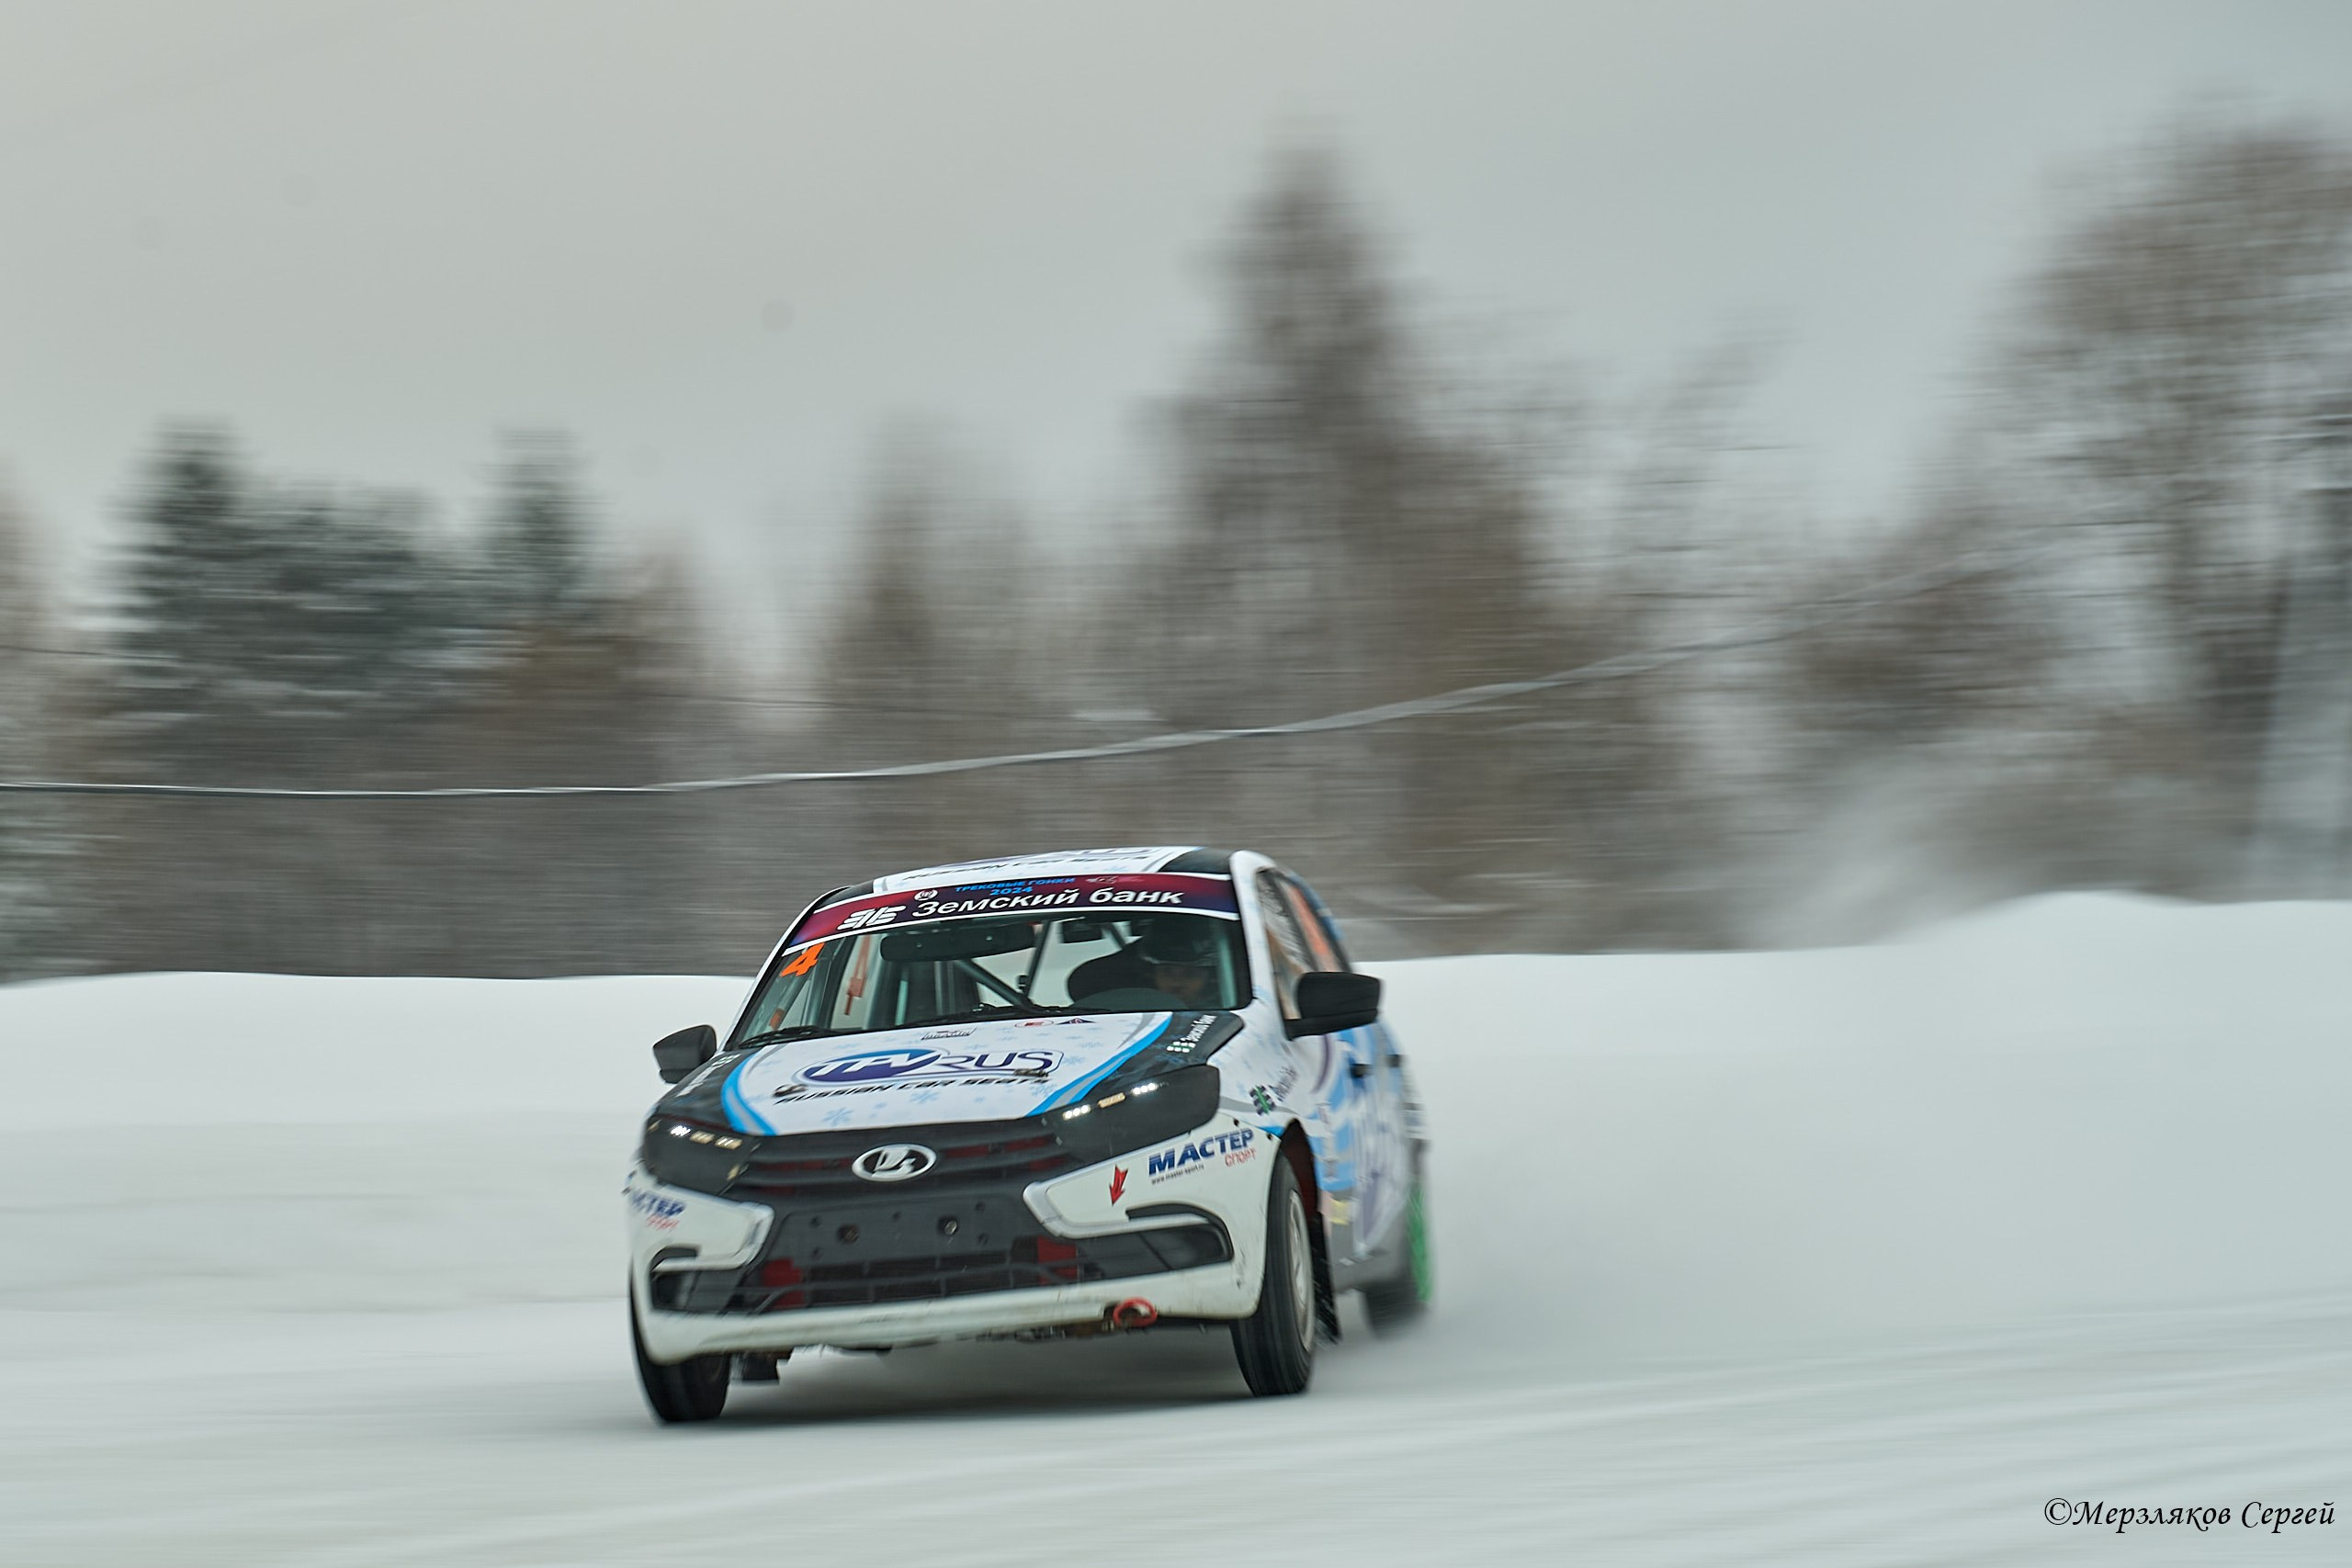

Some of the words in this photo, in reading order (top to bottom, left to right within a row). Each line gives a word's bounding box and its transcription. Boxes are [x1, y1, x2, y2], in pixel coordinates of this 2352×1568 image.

[956, 879, 1027, 893] ТРЕКОВЫЕ
[1028, 876, 1076, 886] ГОНКИ
[989, 886, 1035, 897] 2024
[911, 888, 1080, 918] Земский
[1089, 887, 1185, 906] банк
[779, 942, 825, 977] 4
[1148, 1128, 1254, 1176] МАСТЕР
